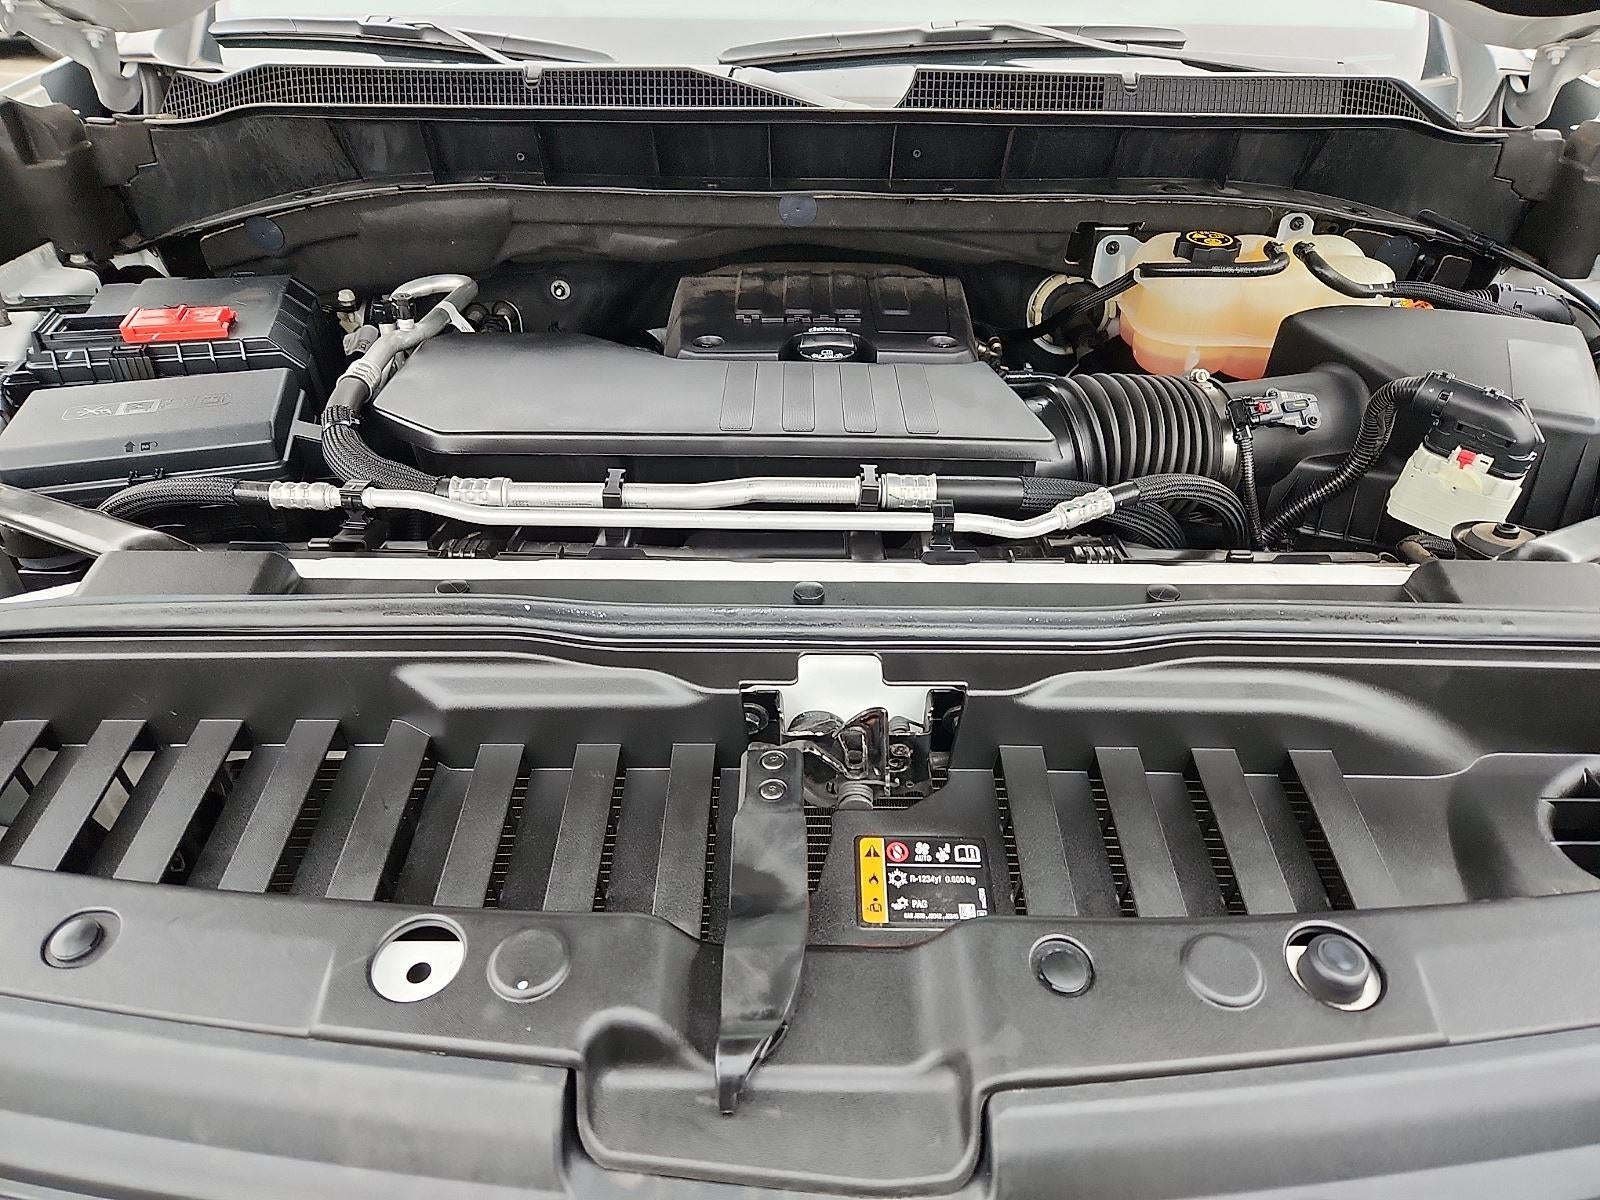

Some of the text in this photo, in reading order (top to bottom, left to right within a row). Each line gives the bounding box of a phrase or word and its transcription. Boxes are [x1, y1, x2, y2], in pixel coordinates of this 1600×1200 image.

[914, 854, 933, 862] AUTO
[909, 875, 942, 885] R-1234yf
[966, 876, 977, 886] kg
[911, 899, 928, 909] PAG
